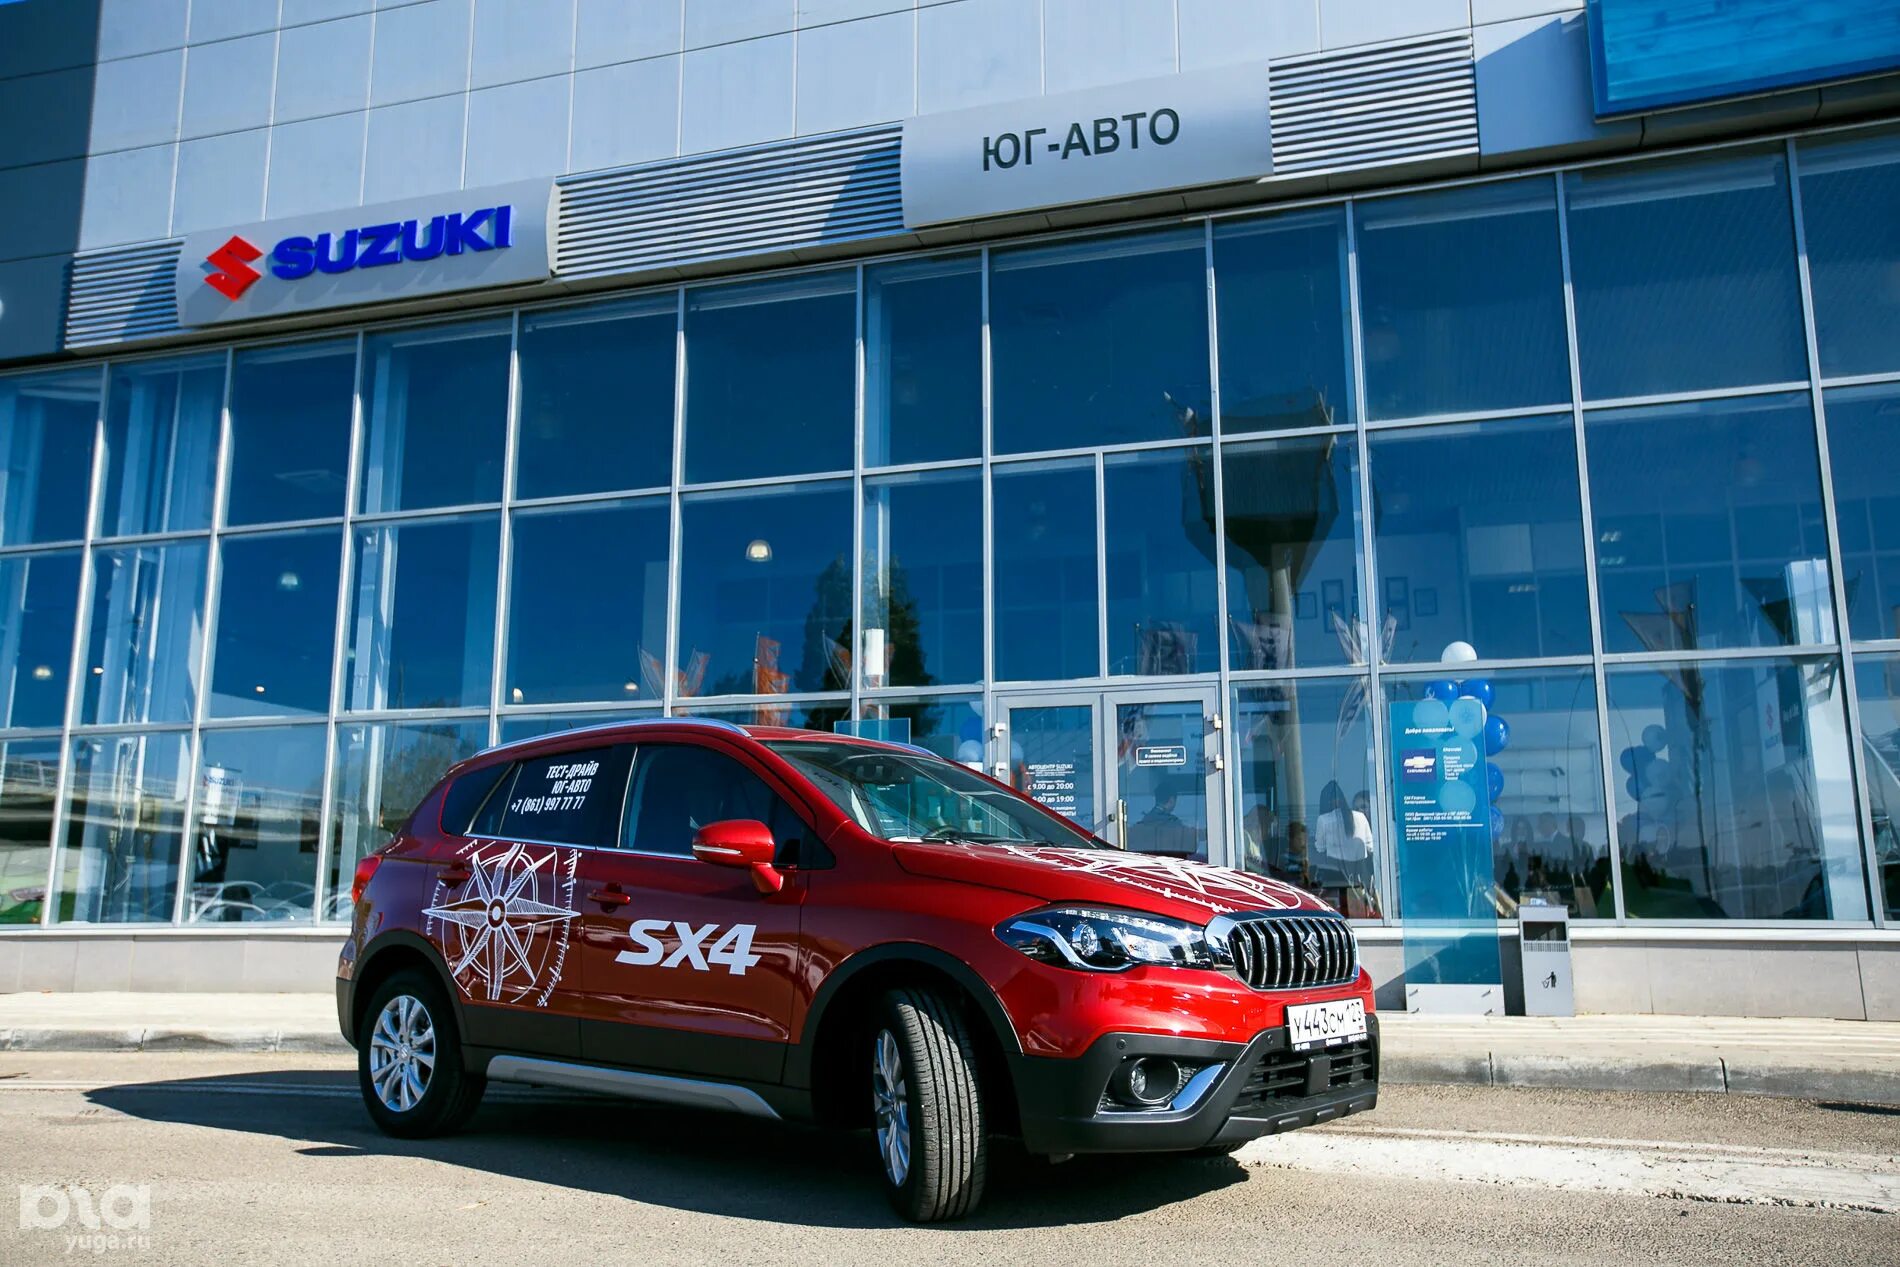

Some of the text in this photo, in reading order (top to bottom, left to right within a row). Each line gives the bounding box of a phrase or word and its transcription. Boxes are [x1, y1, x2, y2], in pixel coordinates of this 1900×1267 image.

[983, 108, 1180, 171] ЮГ-АВТО
[271, 205, 513, 281] SUZUKI
[546, 760, 599, 779] ТЕСТ-ДРАЙВ
[551, 779, 592, 794] ЮГ-АВТО
[511, 796, 586, 815] +7 (861) 997 77 77
[614, 919, 762, 976] SX4
